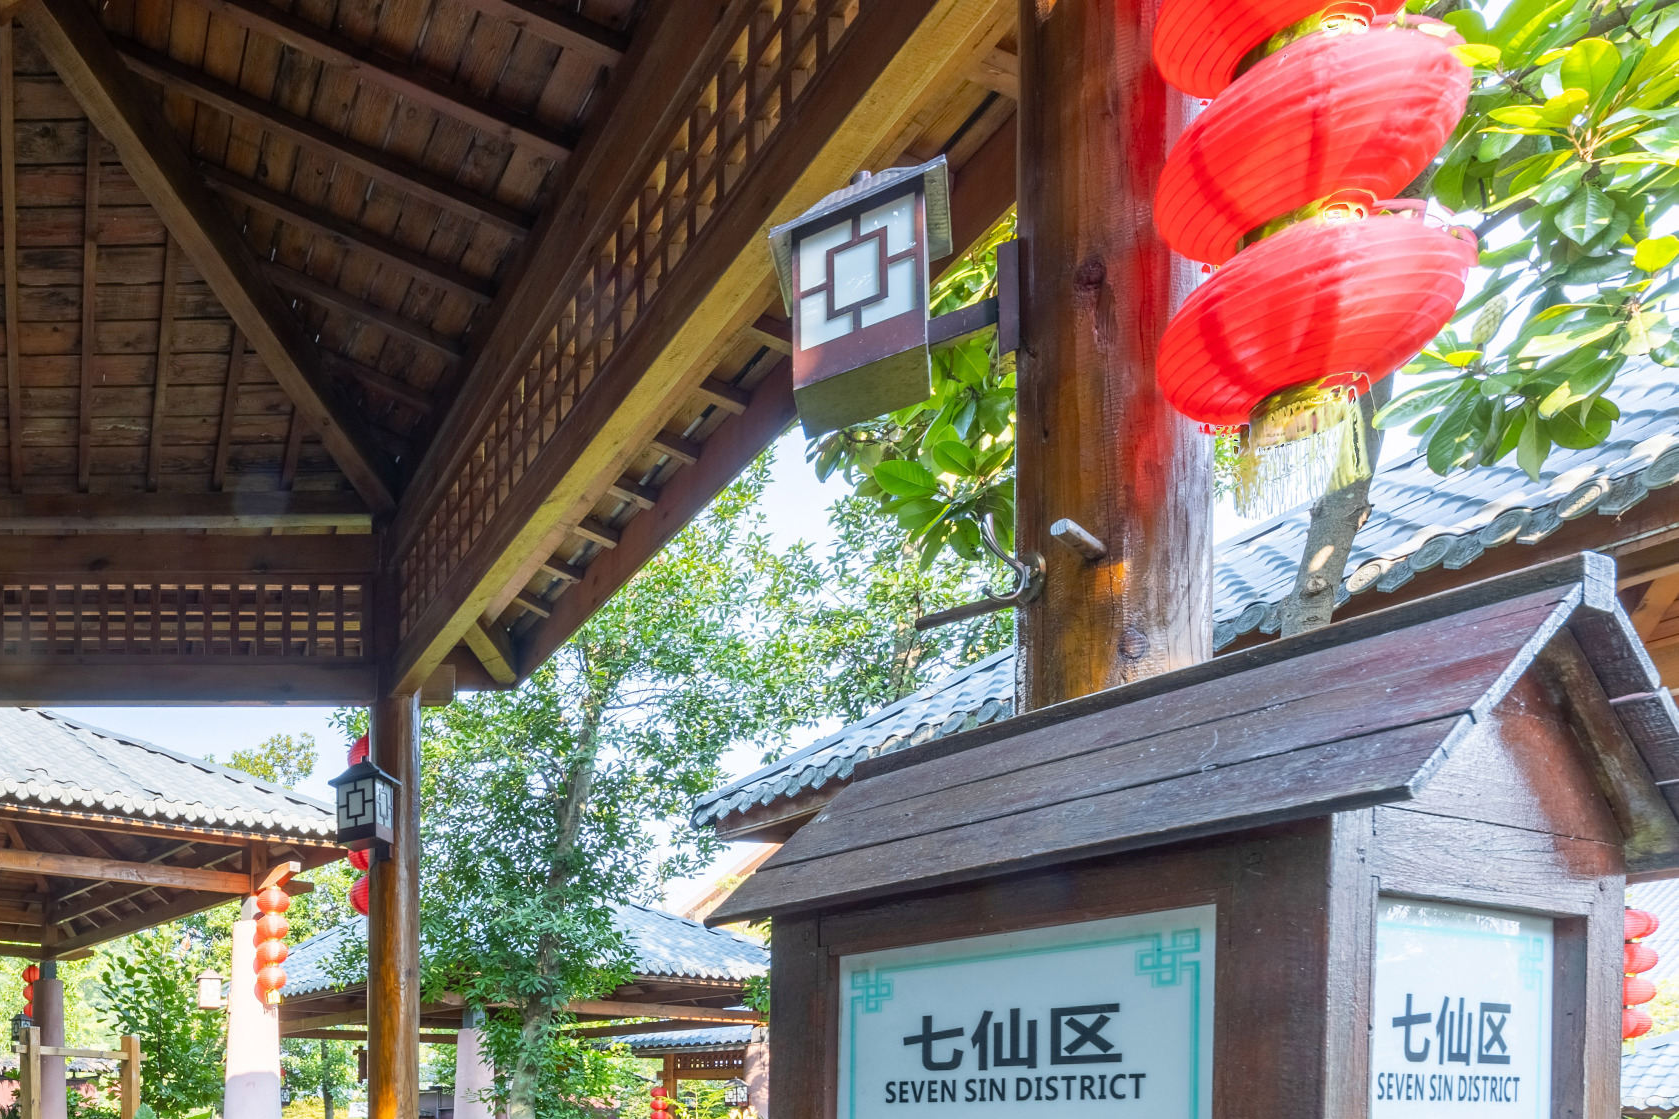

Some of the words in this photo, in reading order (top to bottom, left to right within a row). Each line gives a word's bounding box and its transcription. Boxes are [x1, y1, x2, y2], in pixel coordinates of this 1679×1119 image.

[902, 1002, 1123, 1072] 七仙区
[1391, 992, 1512, 1067] 七仙区
[885, 1079, 957, 1104] SEVEN
[964, 1077, 1006, 1103] SIN
[1015, 1072, 1147, 1102] DISTRICT
[1377, 1071, 1425, 1101] SEVEN
[1429, 1073, 1454, 1102] SIN
[1457, 1074, 1521, 1103] DISTRICT
